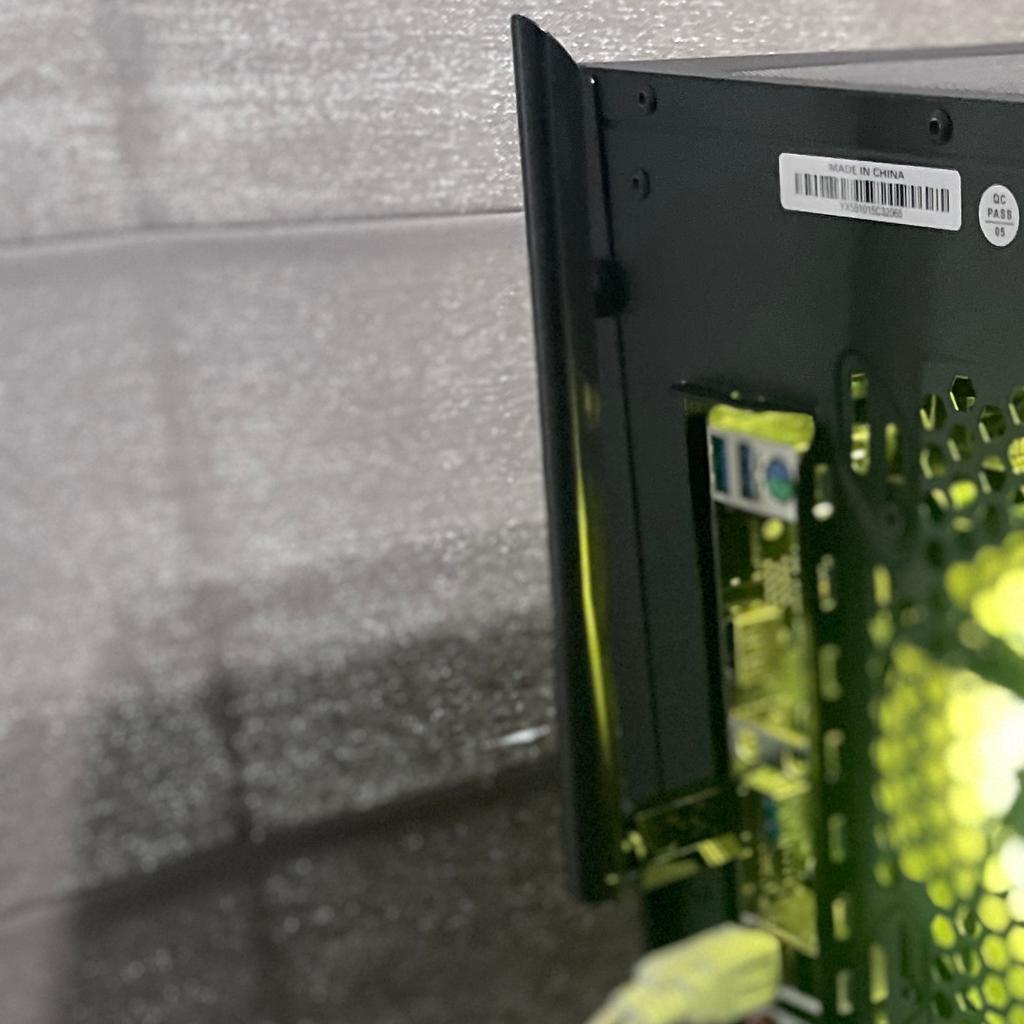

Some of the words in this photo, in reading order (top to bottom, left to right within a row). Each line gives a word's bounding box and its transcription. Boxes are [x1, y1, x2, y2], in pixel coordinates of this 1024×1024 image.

[828, 163, 857, 175] MADE
[859, 166, 870, 177] IN
[872, 167, 905, 180] CHINA
[992, 193, 1007, 205] QC
[987, 207, 1013, 220] PASS
[994, 226, 1006, 237] 05
